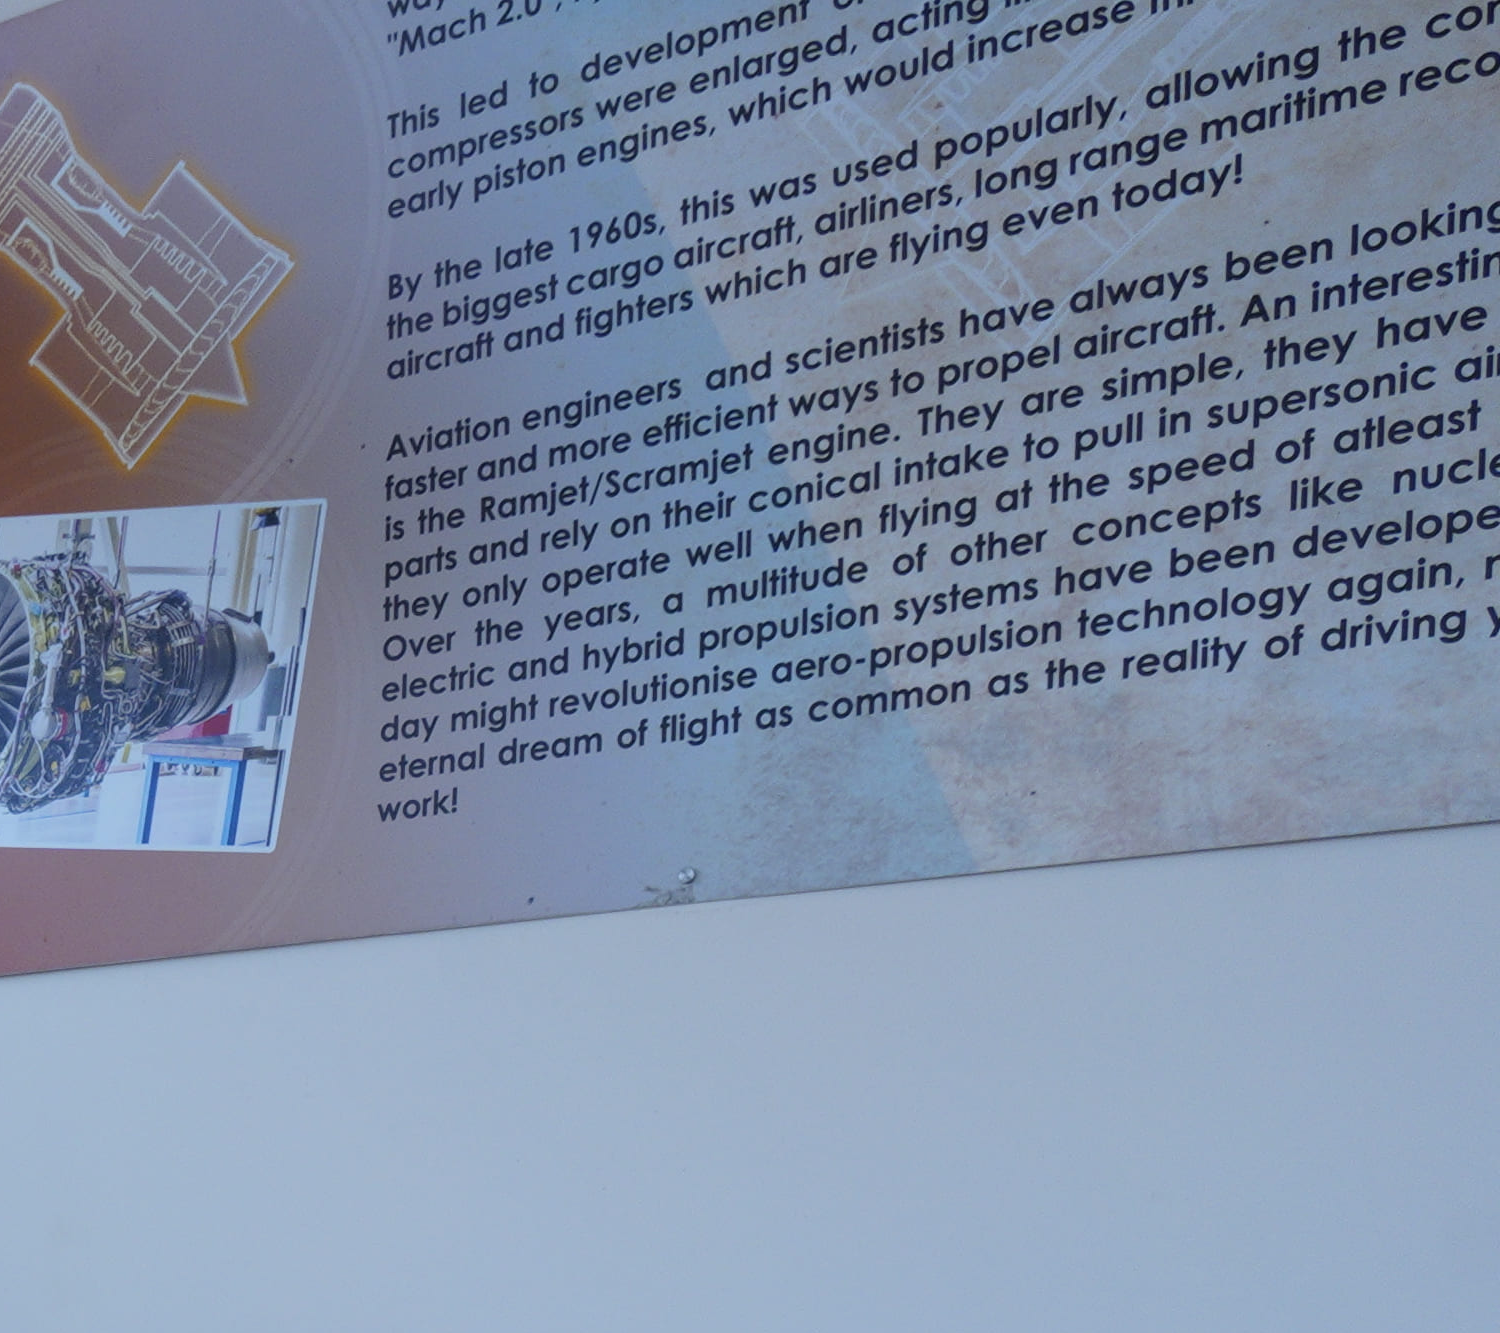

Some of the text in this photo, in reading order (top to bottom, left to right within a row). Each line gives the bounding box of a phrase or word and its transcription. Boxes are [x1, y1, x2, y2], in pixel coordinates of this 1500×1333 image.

[386, 0, 808, 139] This led to development
[387, 8, 487, 57] "Mach
[387, 0, 989, 179] compressors were enlarged, acting
[387, 1, 1135, 219] early piston engines, which would increase
[386, 311, 434, 341] the
[442, 273, 559, 327] biggest
[566, 254, 665, 296] cargo
[673, 215, 803, 270] aircraft,
[814, 183, 963, 236] airliners,
[974, 157, 1058, 199] long
[1068, 127, 1189, 177] range
[1200, 79, 1387, 145] maritime
[386, 152, 1243, 380] aircraft and fighters which are flying even today!
[387, 272, 423, 303] By
[433, 258, 483, 289] the
[494, 238, 555, 274] late
[569, 210, 666, 254] 1960s,
[679, 189, 736, 227] this
[748, 172, 818, 208] was
[832, 138, 919, 188] used
[934, 94, 1127, 171] popularly,
[1145, 45, 1320, 110] allowing
[1337, 24, 1407, 63] the
[384, 465, 469, 502] faster
[476, 443, 538, 482] and
[548, 431, 632, 468] more
[642, 393, 779, 448] efficient
[787, 379, 880, 418] ways
[889, 367, 926, 398] to
[937, 333, 1061, 396] propel
[1073, 303, 1225, 360] aircraft.
[1239, 293, 1297, 328] An
[386, 416, 511, 462] Aviation
[522, 378, 682, 431] engineers
[705, 350, 772, 392] and
[785, 317, 945, 375] scientists
[959, 297, 1056, 338] have
[1068, 264, 1209, 314] always
[1224, 237, 1334, 283] been
